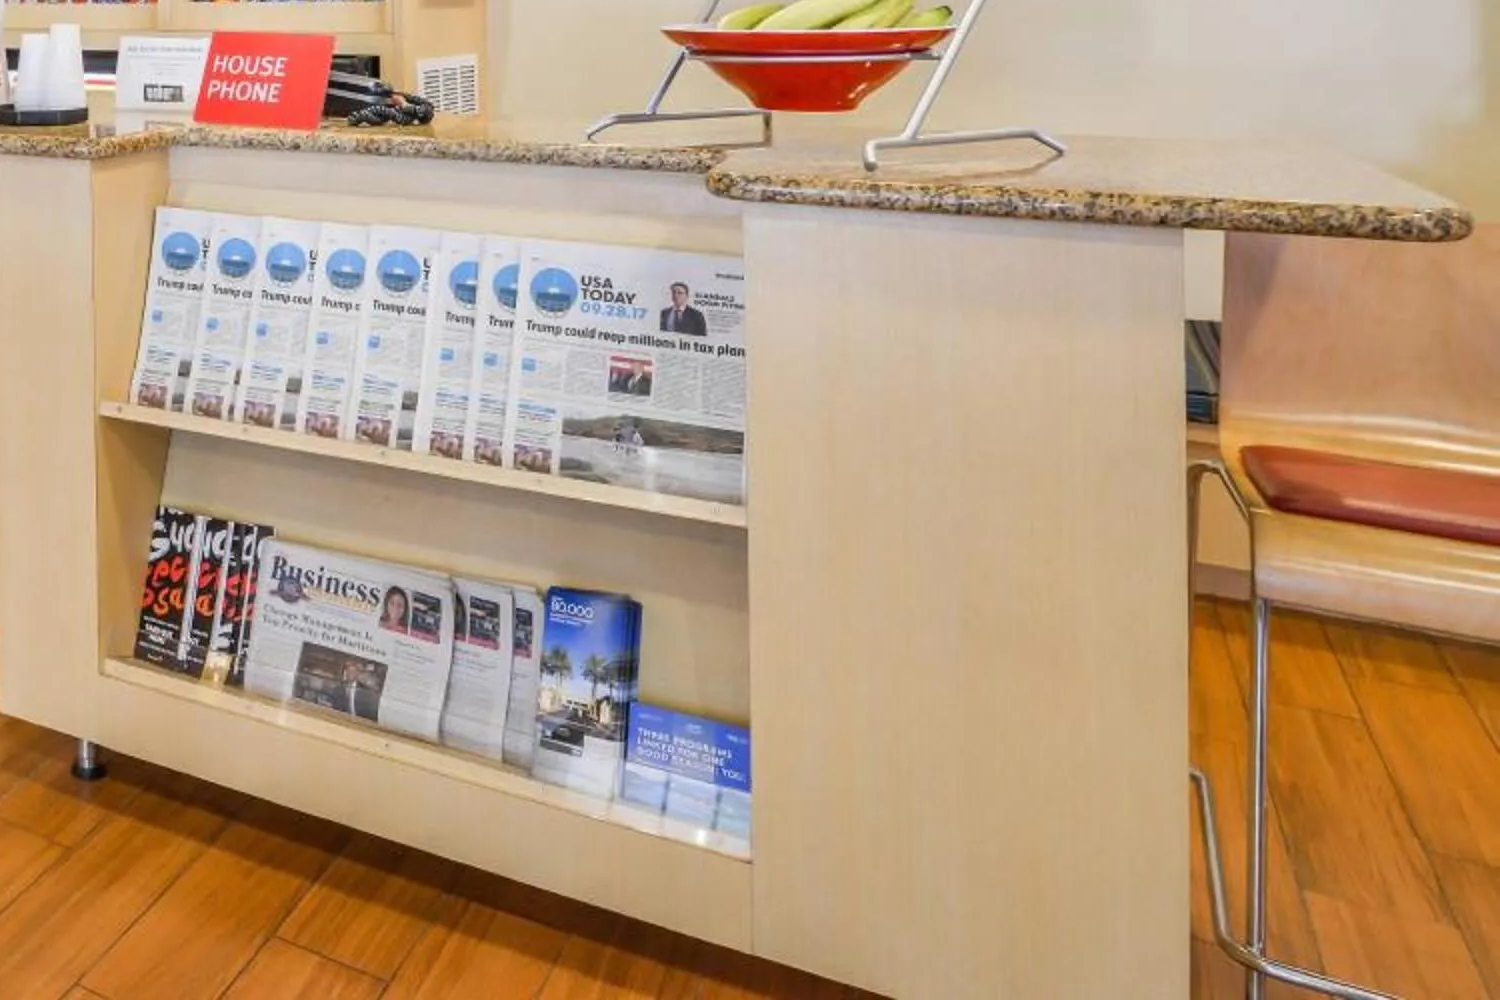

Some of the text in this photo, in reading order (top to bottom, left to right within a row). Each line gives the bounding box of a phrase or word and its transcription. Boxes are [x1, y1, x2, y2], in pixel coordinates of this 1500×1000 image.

[212, 54, 288, 78] HOUSE
[206, 79, 283, 104] PHONE
[157, 276, 185, 291] Trump
[580, 274, 613, 289] USA
[212, 284, 241, 299] Trump
[261, 289, 291, 305] Trump
[579, 287, 637, 306] TODAY
[320, 295, 353, 312] Trump
[372, 299, 405, 316] Trump
[579, 301, 649, 321] 09.28.17
[526, 319, 746, 358] Trump could reap millions in tax plan
[270, 555, 381, 608] Business
